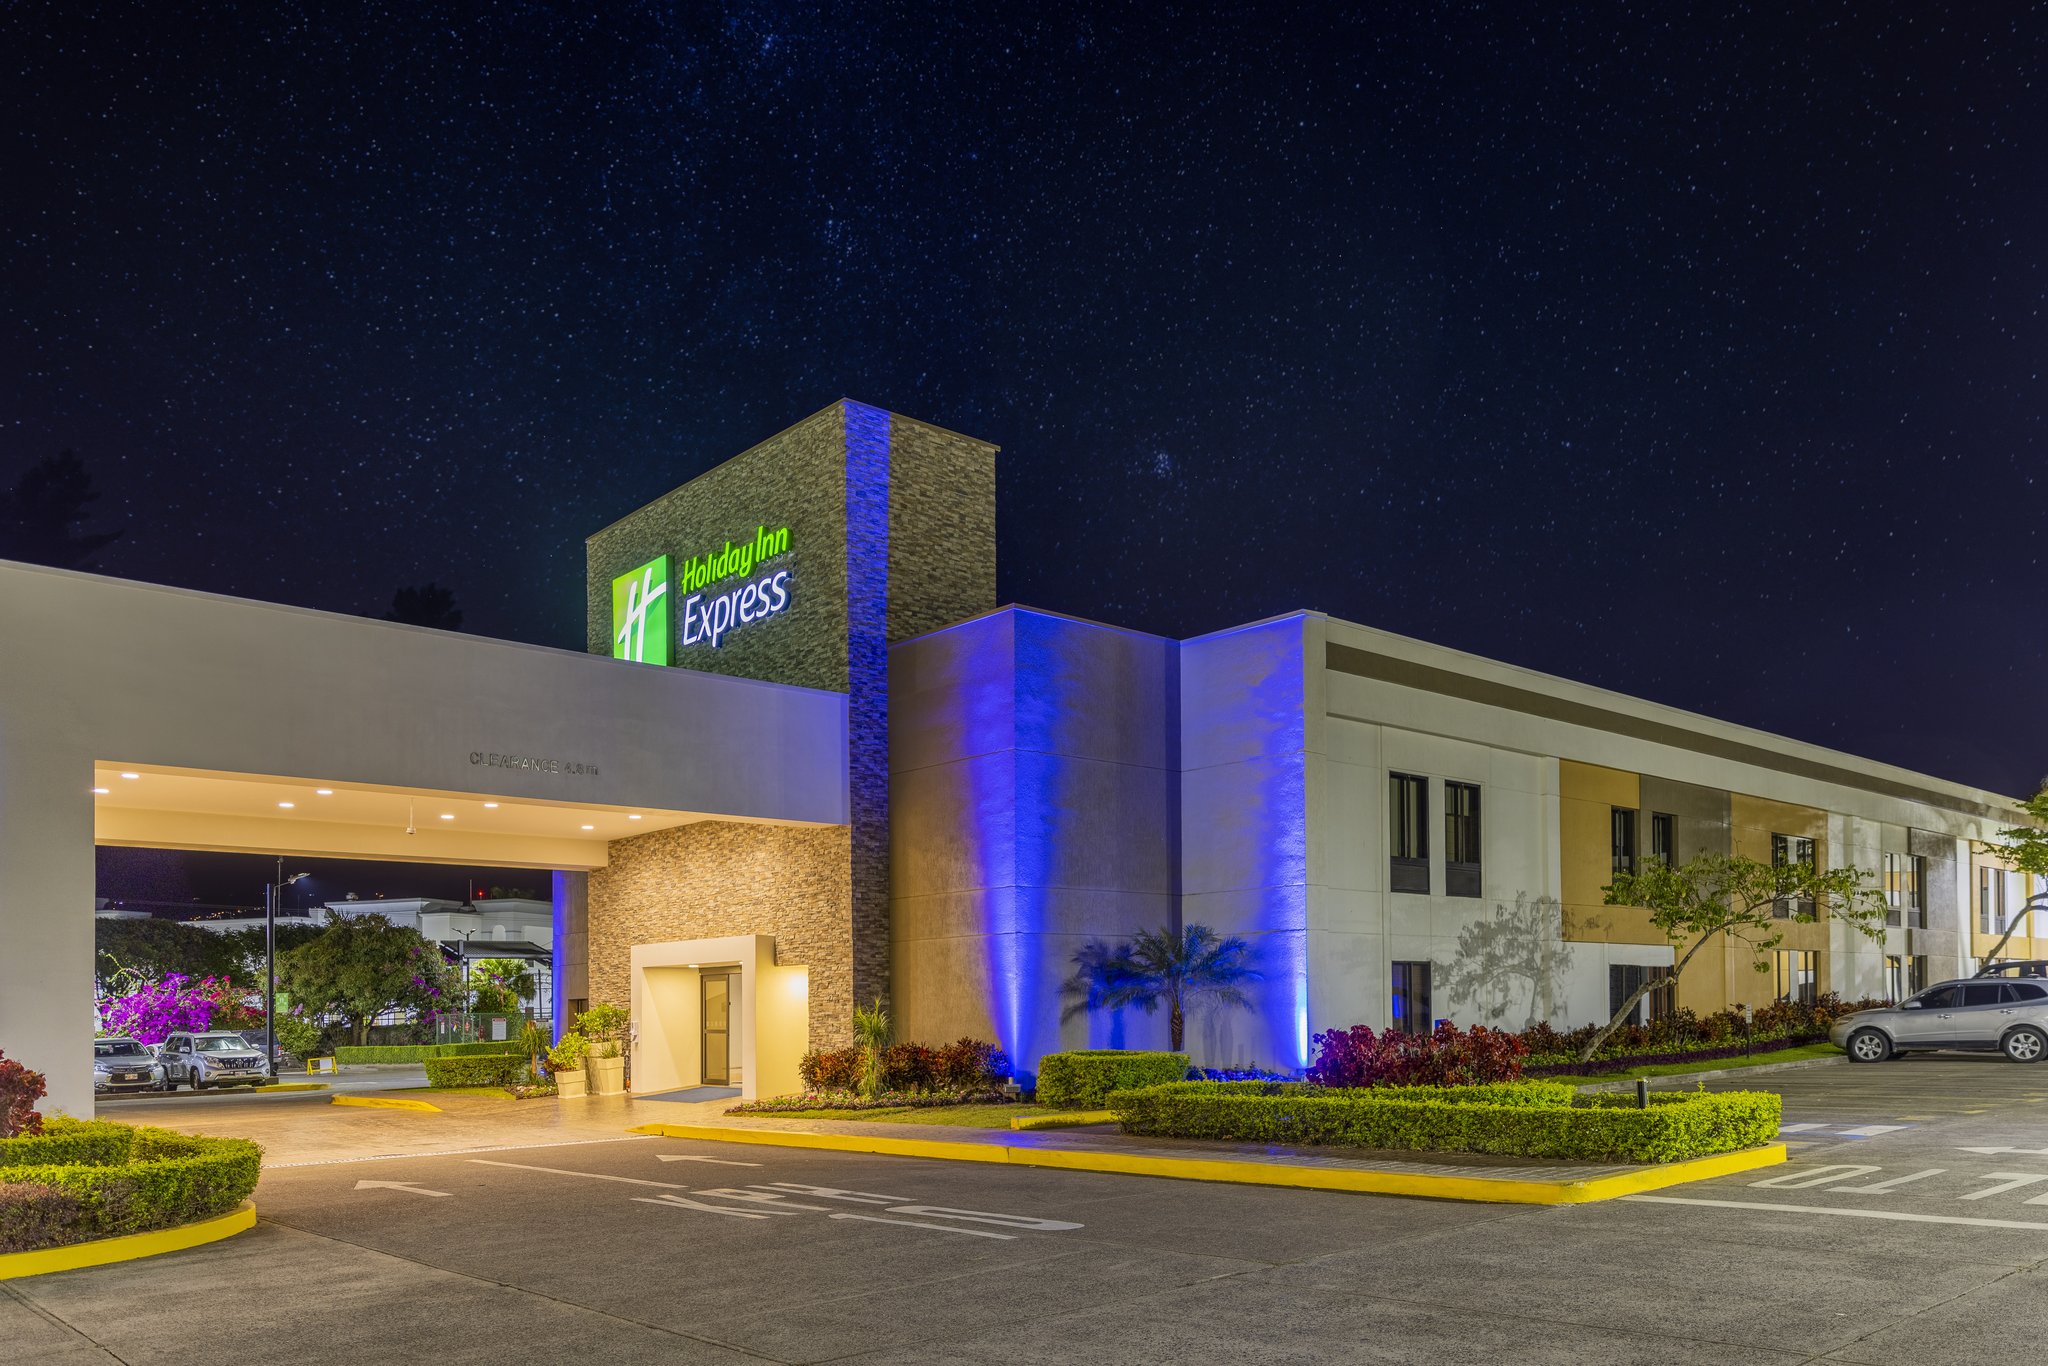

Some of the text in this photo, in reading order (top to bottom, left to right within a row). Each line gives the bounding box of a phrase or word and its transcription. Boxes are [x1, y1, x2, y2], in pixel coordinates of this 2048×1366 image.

[682, 525, 792, 595] Holiday Inn
[682, 571, 792, 648] Express
[469, 752, 559, 774] CLEARANCE
[629, 1182, 918, 1219] KPH
[1746, 1164, 2048, 1205] LTO
[827, 1205, 1086, 1240] 10
